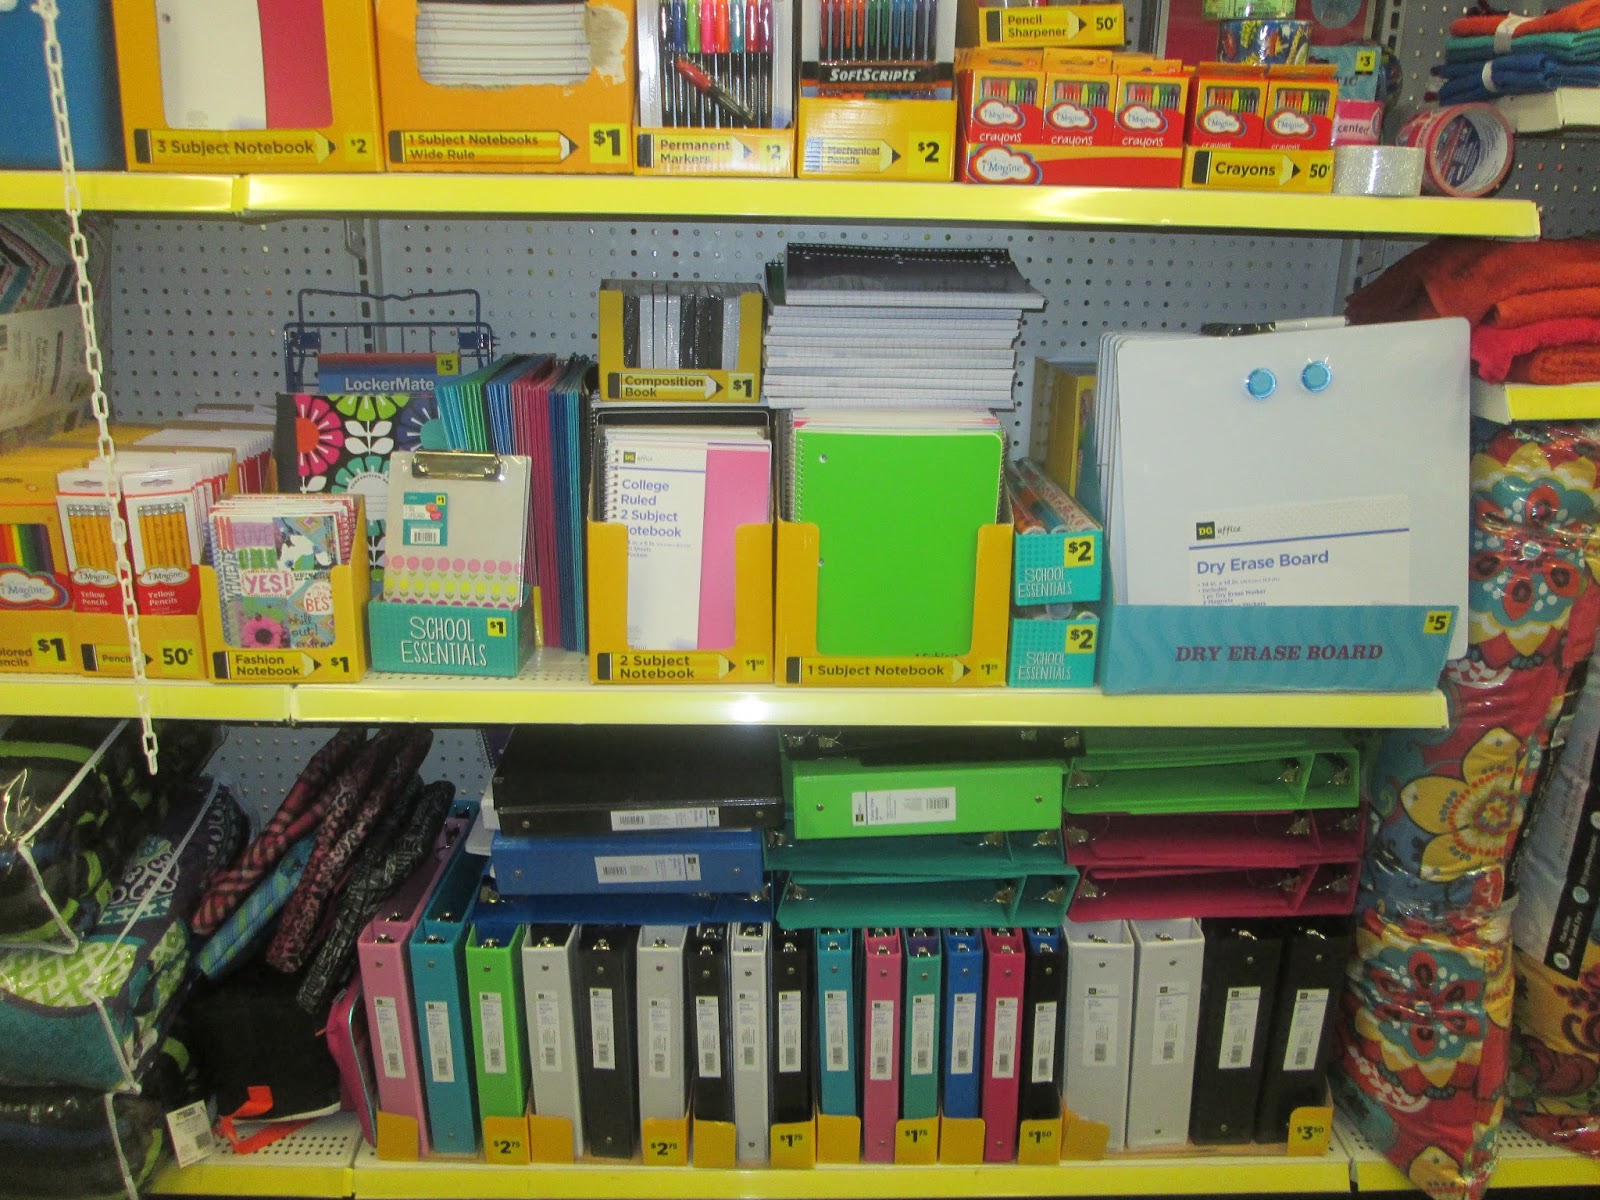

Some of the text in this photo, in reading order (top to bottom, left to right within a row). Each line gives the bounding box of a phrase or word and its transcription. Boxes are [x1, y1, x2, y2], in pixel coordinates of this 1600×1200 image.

[1008, 15, 1042, 25] Pencil
[1008, 27, 1067, 39] Sharpener
[409, 134, 538, 147] 1 Subject Notebooks
[593, 129, 621, 156] $1
[660, 139, 731, 151] Permanent
[979, 132, 1022, 145] crayons
[1051, 135, 1093, 147] crayons
[1122, 136, 1164, 147] crayons
[157, 139, 314, 156] 3 Subject Notebook
[351, 139, 367, 153] $2
[766, 144, 781, 160] $2
[827, 146, 880, 156] Mechanical
[918, 142, 940, 163] $2
[410, 150, 475, 160] Wide Rule
[660, 153, 711, 164] Markers
[827, 156, 860, 166] Pencils
[1215, 162, 1276, 178] Crayons
[442, 360, 453, 371] $5
[345, 377, 434, 391] LockerMate
[625, 375, 704, 389] Composition
[733, 380, 752, 398] $1
[625, 388, 657, 397] Book
[622, 479, 670, 493] College
[621, 495, 657, 506] Ruled
[621, 510, 678, 523] 2 Subject
[626, 525, 682, 537] otebook
[1068, 541, 1092, 562] $2
[1197, 550, 1329, 575] Dry Erase Board
[1025, 567, 1065, 583] SCHOOL
[244, 572, 296, 597] YES!
[1018, 581, 1072, 598] ESSENTIALS
[148, 591, 175, 599] Yellow
[149, 598, 178, 606] Pencils
[305, 597, 333, 613] BES
[410, 616, 475, 643] SCHOOL
[490, 621, 504, 635] $1
[1428, 615, 1447, 631] $5
[1070, 629, 1093, 650] $2
[37, 638, 66, 661] $1
[401, 641, 487, 667] ESSENTIALS
[1175, 644, 1384, 662] DRY ERASE BOARD
[102, 654, 133, 663] Pencil
[235, 655, 284, 665] Fashion
[331, 657, 349, 673] $1
[620, 655, 690, 667] 2 Subject
[1026, 652, 1065, 666] SCHOOL
[237, 666, 300, 676] Notebook
[620, 668, 695, 679] Notebook
[808, 665, 944, 679] 1 Subject Notebook
[1018, 665, 1072, 681] ESSENTIALS
